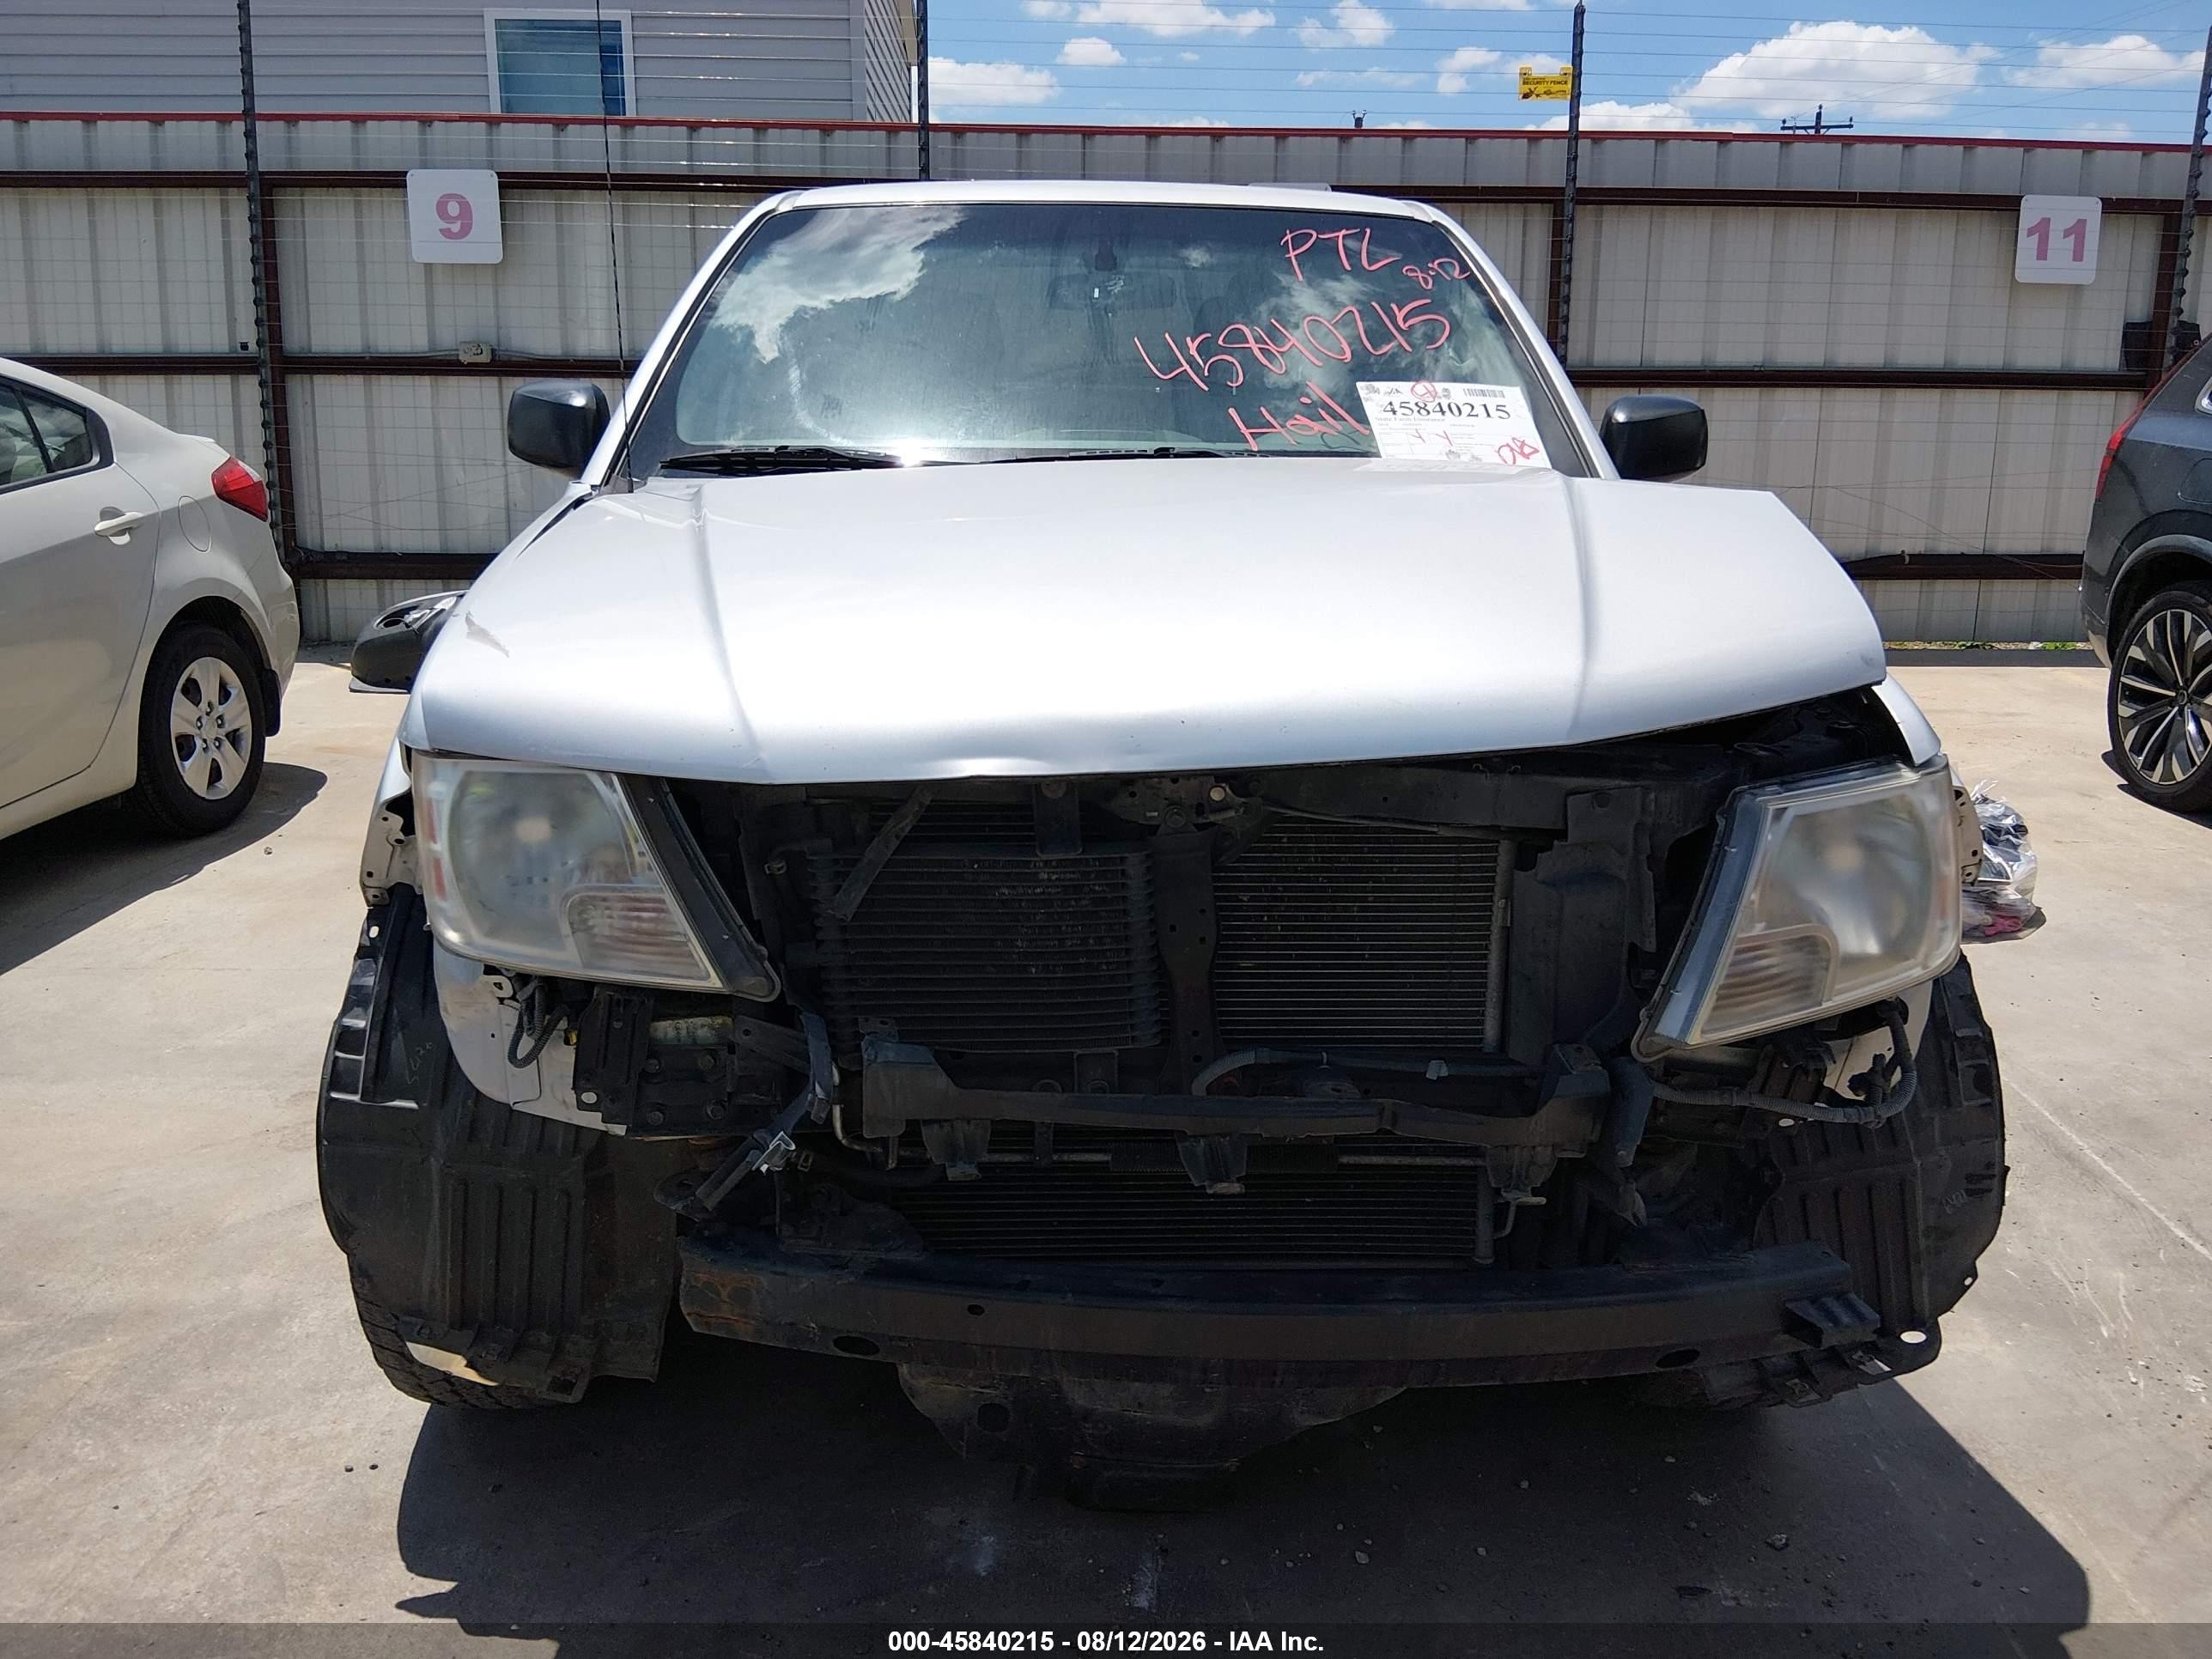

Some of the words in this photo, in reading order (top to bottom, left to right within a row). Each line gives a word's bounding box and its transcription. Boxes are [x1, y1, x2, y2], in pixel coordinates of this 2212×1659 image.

[435, 192, 474, 240] 9
[2026, 216, 2087, 262] 11
[1279, 227, 1402, 283] PTL
[1133, 298, 1451, 392] 45840215
[1228, 380, 1371, 452] Hail
[1382, 399, 1511, 420] 45840215
